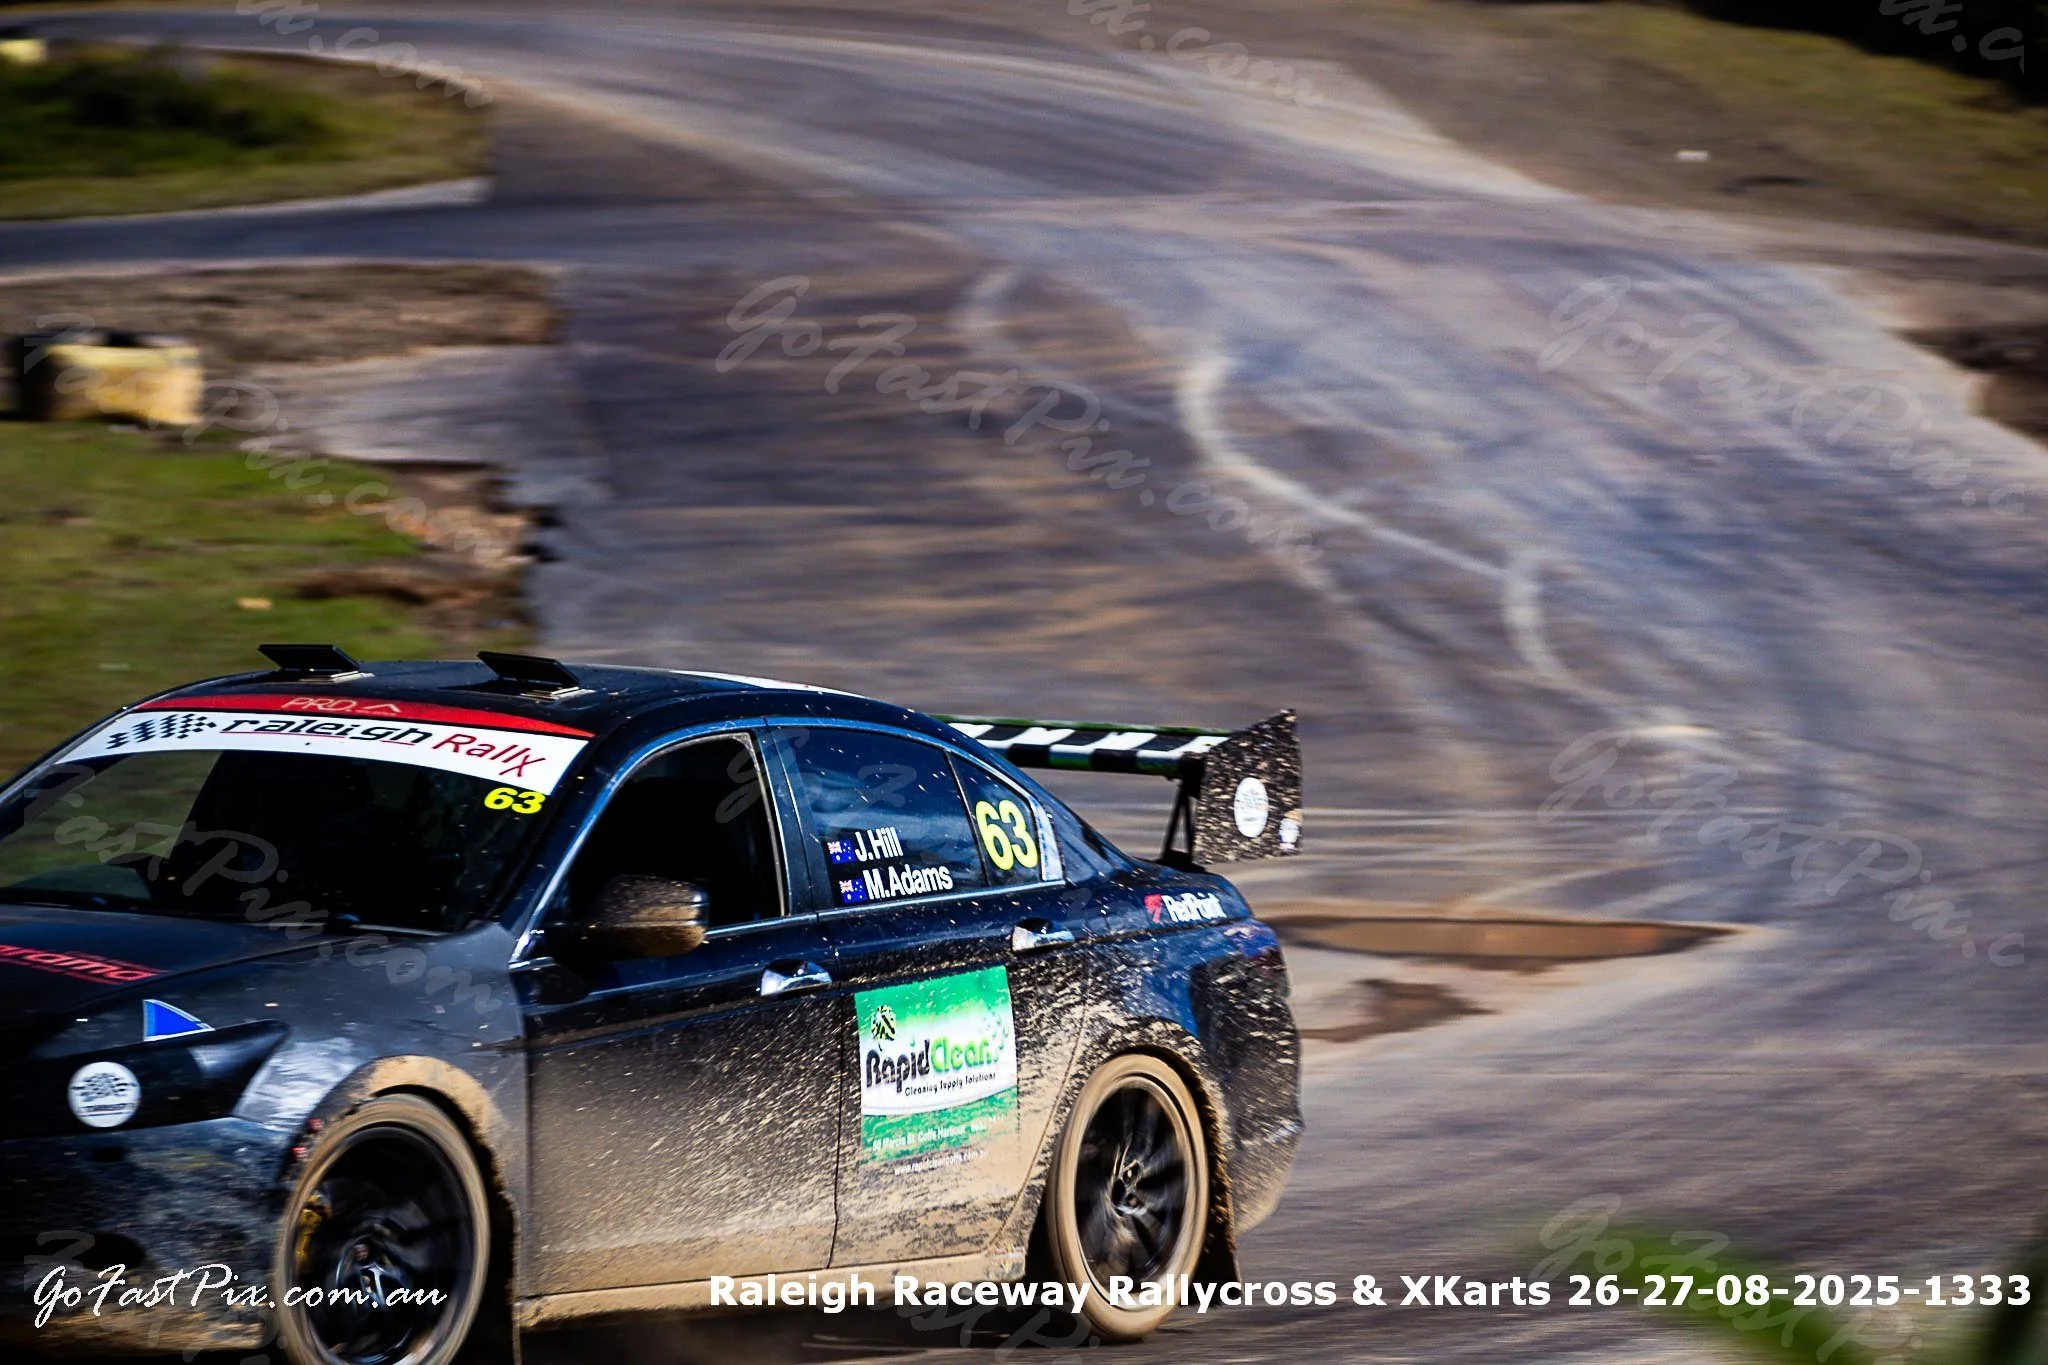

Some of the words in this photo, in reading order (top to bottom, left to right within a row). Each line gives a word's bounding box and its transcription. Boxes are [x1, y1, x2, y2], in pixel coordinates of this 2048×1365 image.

[220, 717, 433, 744] raleigh
[432, 733, 546, 777] Rally
[484, 787, 546, 814] 63
[854, 826, 904, 862] J.Hill
[975, 799, 1038, 871] 63
[862, 863, 953, 900] M.Adams
[866, 1036, 993, 1093] RapidClean
[904, 1083, 938, 1096] Cleaning
[940, 1077, 963, 1091] Supply
[965, 1072, 997, 1085] Solutions
